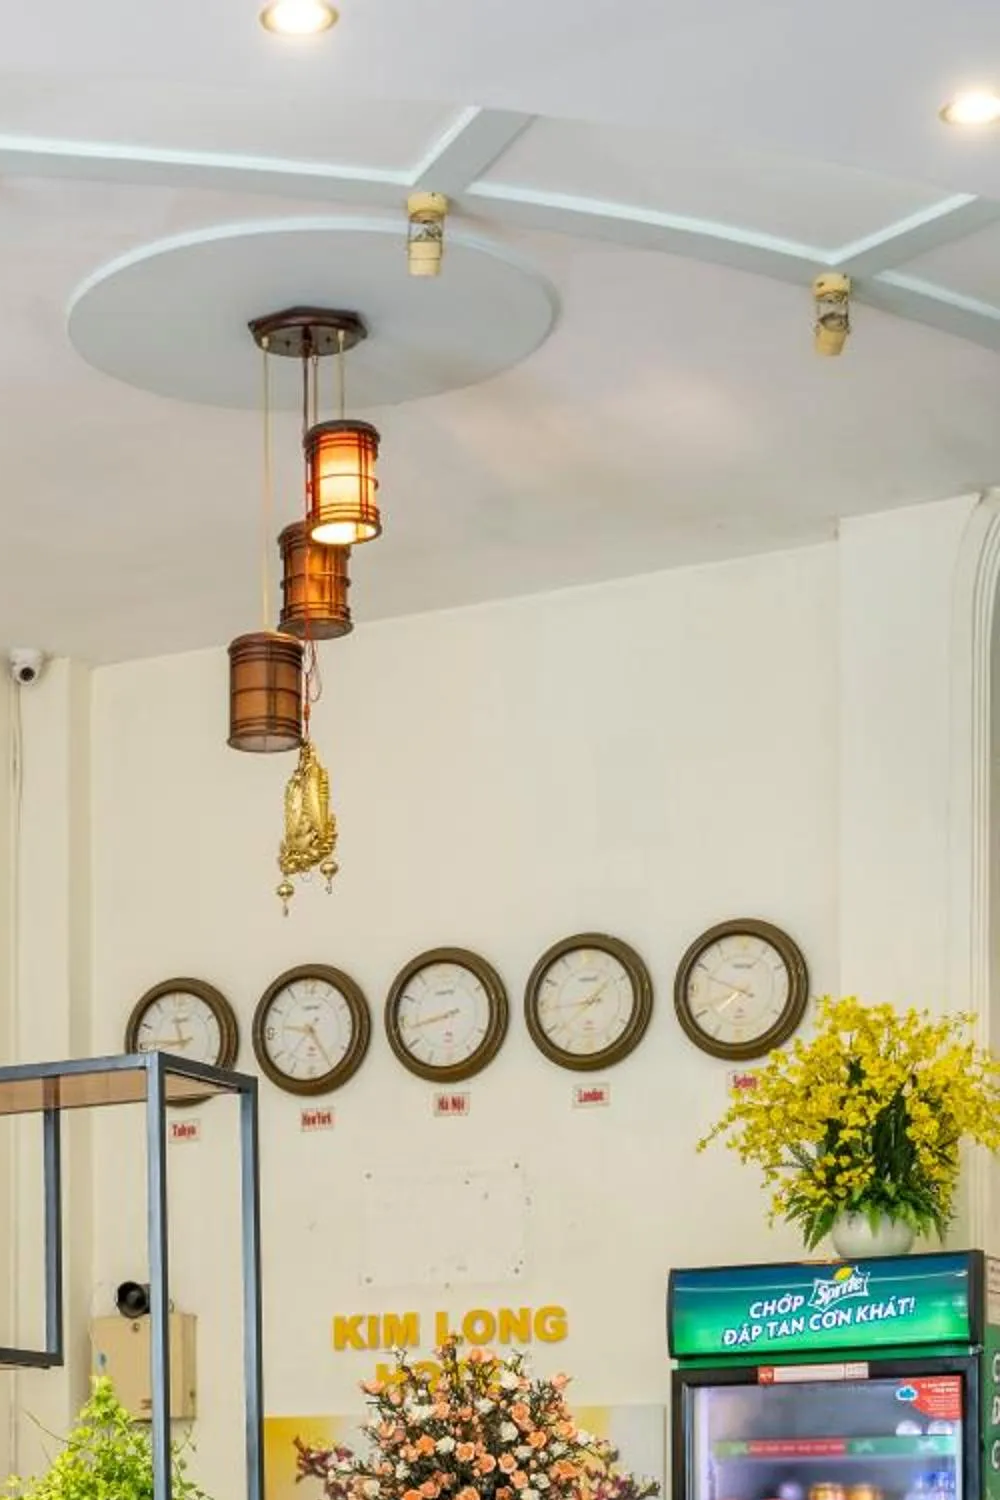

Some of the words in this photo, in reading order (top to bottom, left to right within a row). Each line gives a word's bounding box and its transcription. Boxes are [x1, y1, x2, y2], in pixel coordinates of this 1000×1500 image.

[750, 1293, 805, 1319] CHỚP
[815, 1276, 864, 1304] Sprite
[766, 1317, 805, 1339] TAN
[809, 1309, 851, 1331] CƠN
[855, 1295, 915, 1323] KHÁT!
[332, 1311, 420, 1351] KIM
[435, 1305, 569, 1346] LONG
